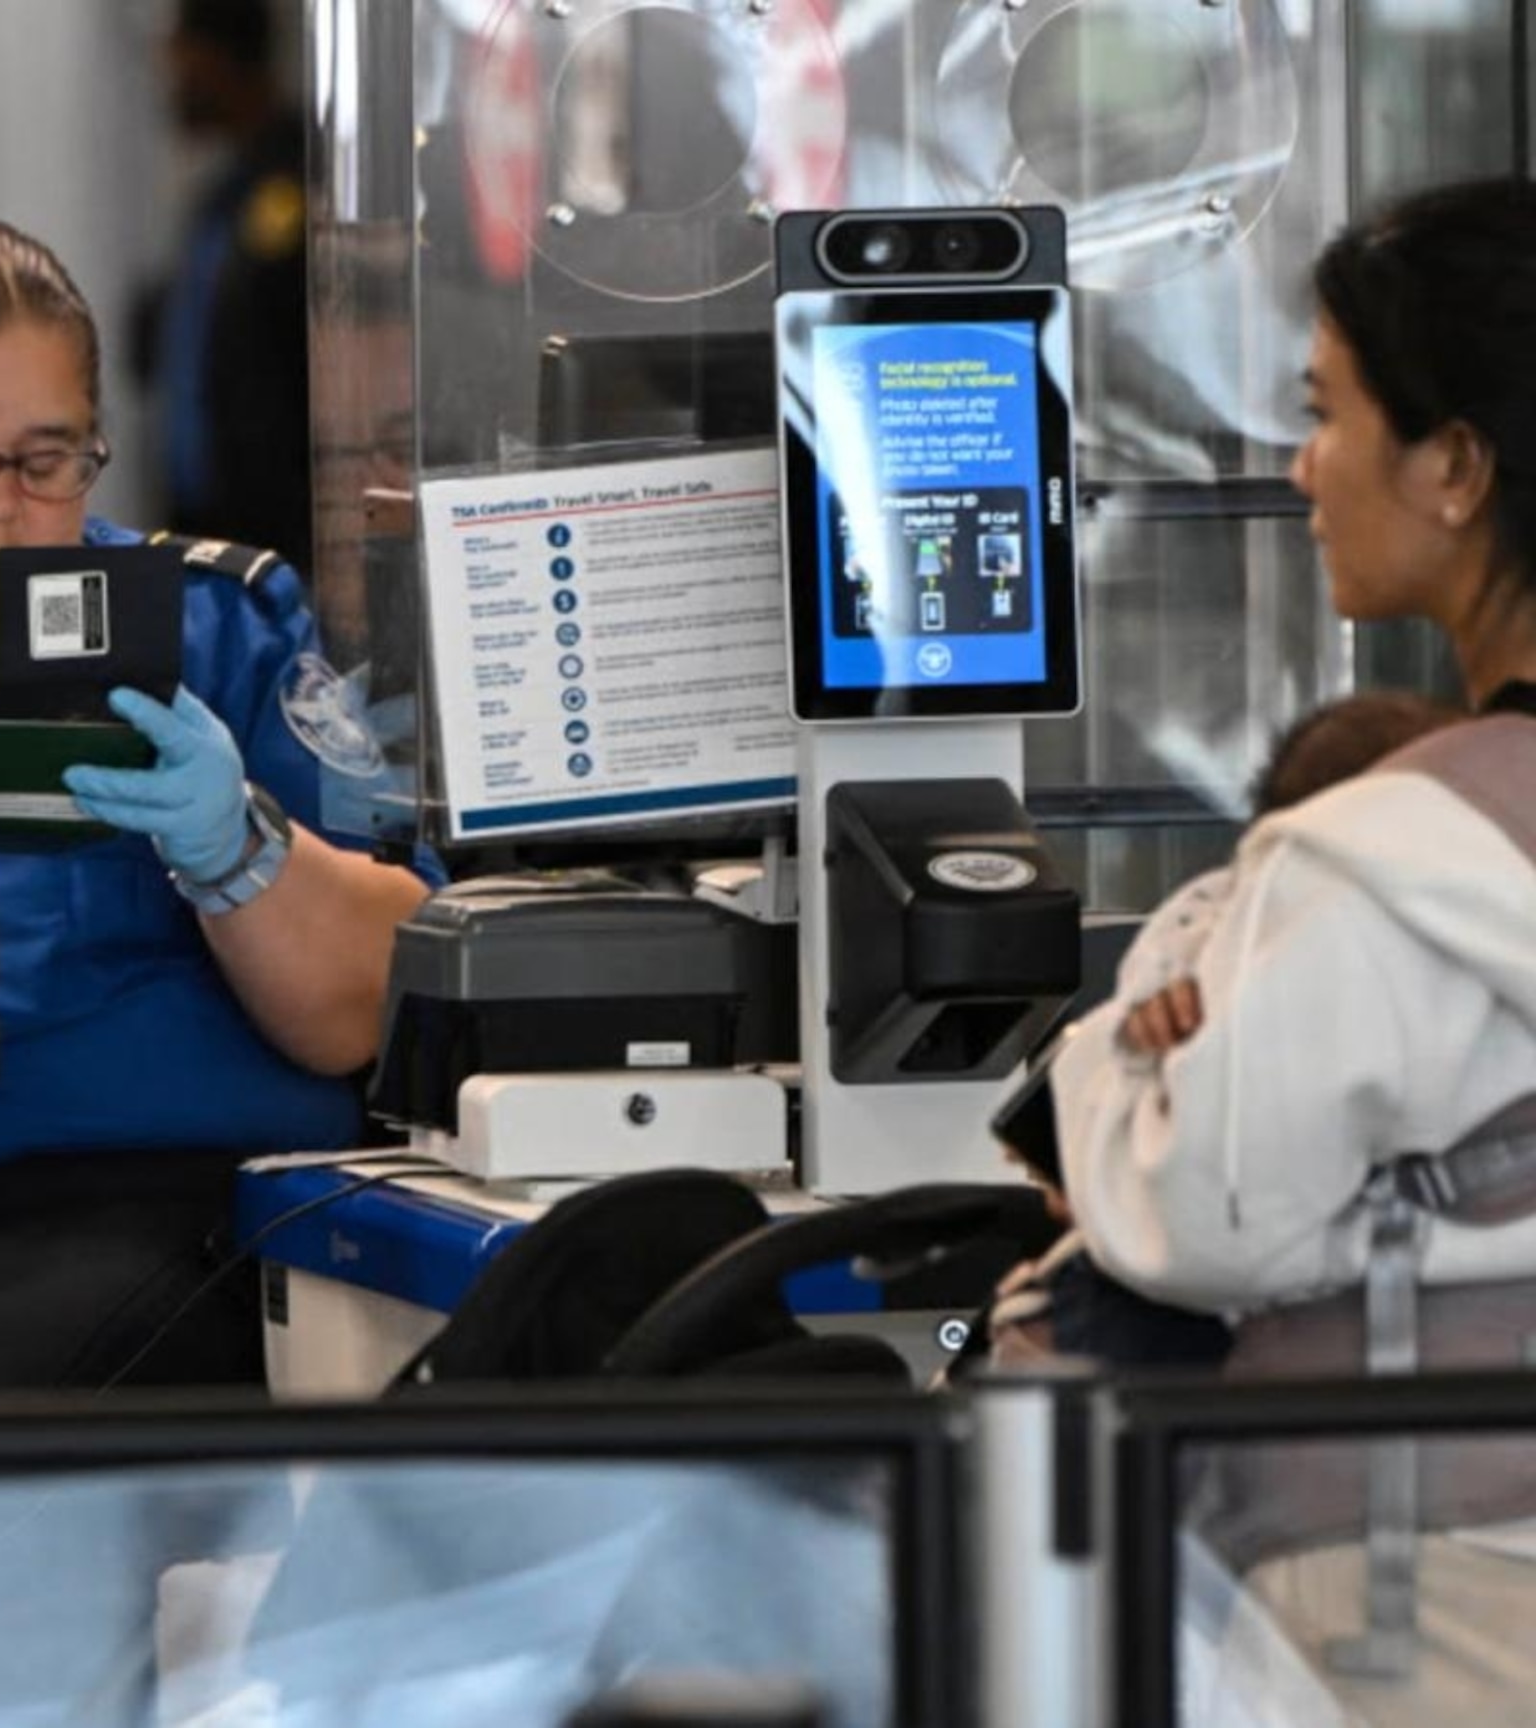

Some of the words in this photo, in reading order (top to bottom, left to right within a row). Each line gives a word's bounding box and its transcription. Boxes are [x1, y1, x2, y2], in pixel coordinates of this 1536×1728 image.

[878, 361, 914, 375] Facial
[917, 359, 988, 377] recognition
[880, 376, 947, 391] technology
[880, 398, 917, 411] Photo
[968, 396, 998, 409] after
[926, 434, 947, 447] the
[949, 433, 989, 446] officer
[985, 449, 1013, 464] your
[452, 505, 477, 518] TSA
[554, 494, 594, 507] Travel
[641, 484, 681, 499] Travel
[683, 480, 713, 495] Safe
